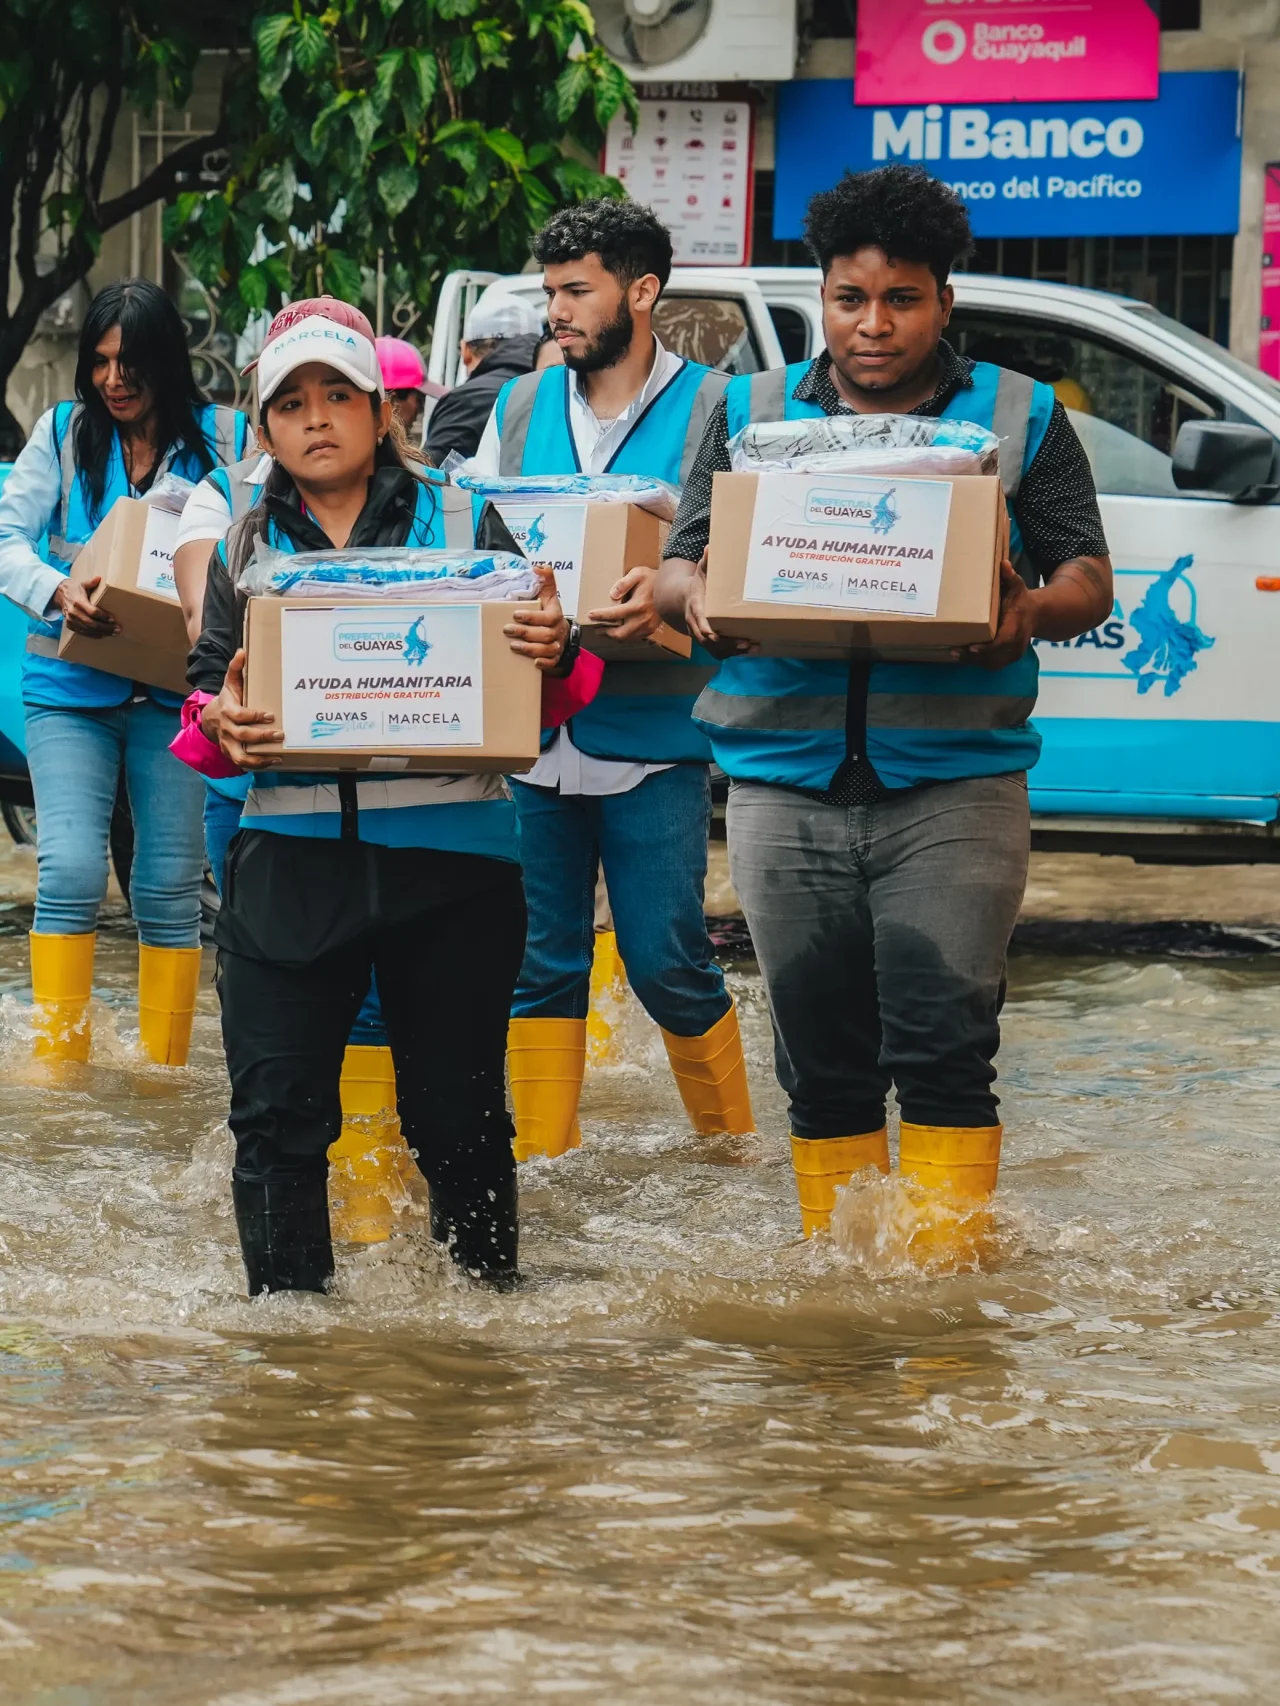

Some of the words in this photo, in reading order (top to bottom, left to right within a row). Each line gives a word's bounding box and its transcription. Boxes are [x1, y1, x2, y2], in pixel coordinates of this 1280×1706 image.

[973, 22, 1045, 41] Banco
[972, 35, 1087, 63] Guayaquil
[1002, 176, 1039, 198] del
[1047, 174, 1142, 198] Pacífico
[274, 329, 357, 354] MARCELA
[824, 506, 872, 518] GUAYAS
[762, 535, 817, 550] AYUDA
[821, 540, 934, 560] HUMANITARIA
[150, 549, 174, 561] AYU
[789, 552, 853, 563] DISTRIBUCIÓN
[855, 557, 902, 567] GRATUITA
[778, 569, 828, 581] GUAYAS
[847, 578, 918, 593] MARCELA
[338, 632, 402, 641] PREFECTURA
[353, 640, 403, 651] GUAYAS
[294, 678, 352, 690] AYUDA
[357, 676, 473, 688] HUMANITARIA
[324, 691, 390, 700] DISTRIBUCIÓN
[393, 691, 441, 699] GRATUITA
[315, 711, 368, 721] GUAYAS
[388, 713, 461, 724] MARCELA
